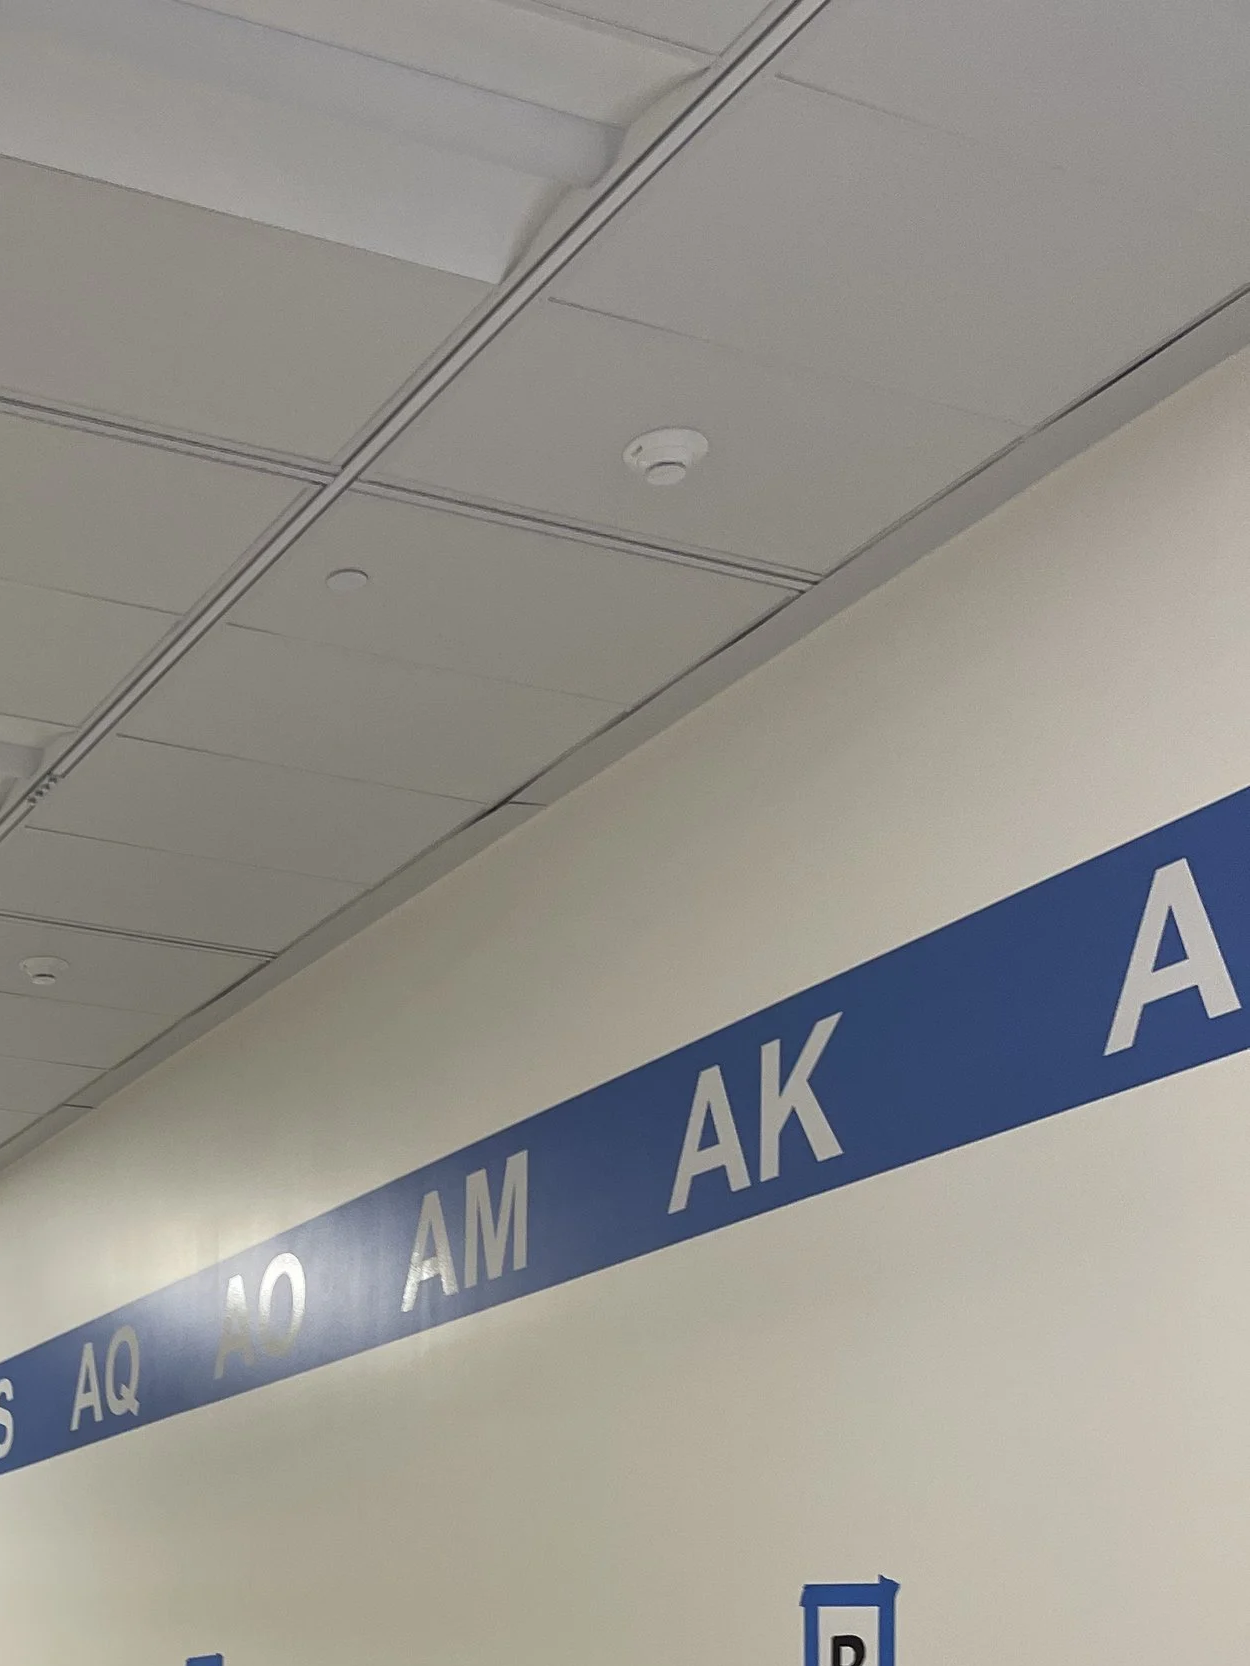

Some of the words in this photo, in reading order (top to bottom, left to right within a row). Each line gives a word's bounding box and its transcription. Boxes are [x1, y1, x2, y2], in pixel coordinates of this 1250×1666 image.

[70, 1325, 141, 1431] AQ
[213, 1251, 307, 1381] AO
[400, 1149, 529, 1314] AM
[667, 1011, 844, 1215] AK
[1102, 857, 1243, 1057] A
